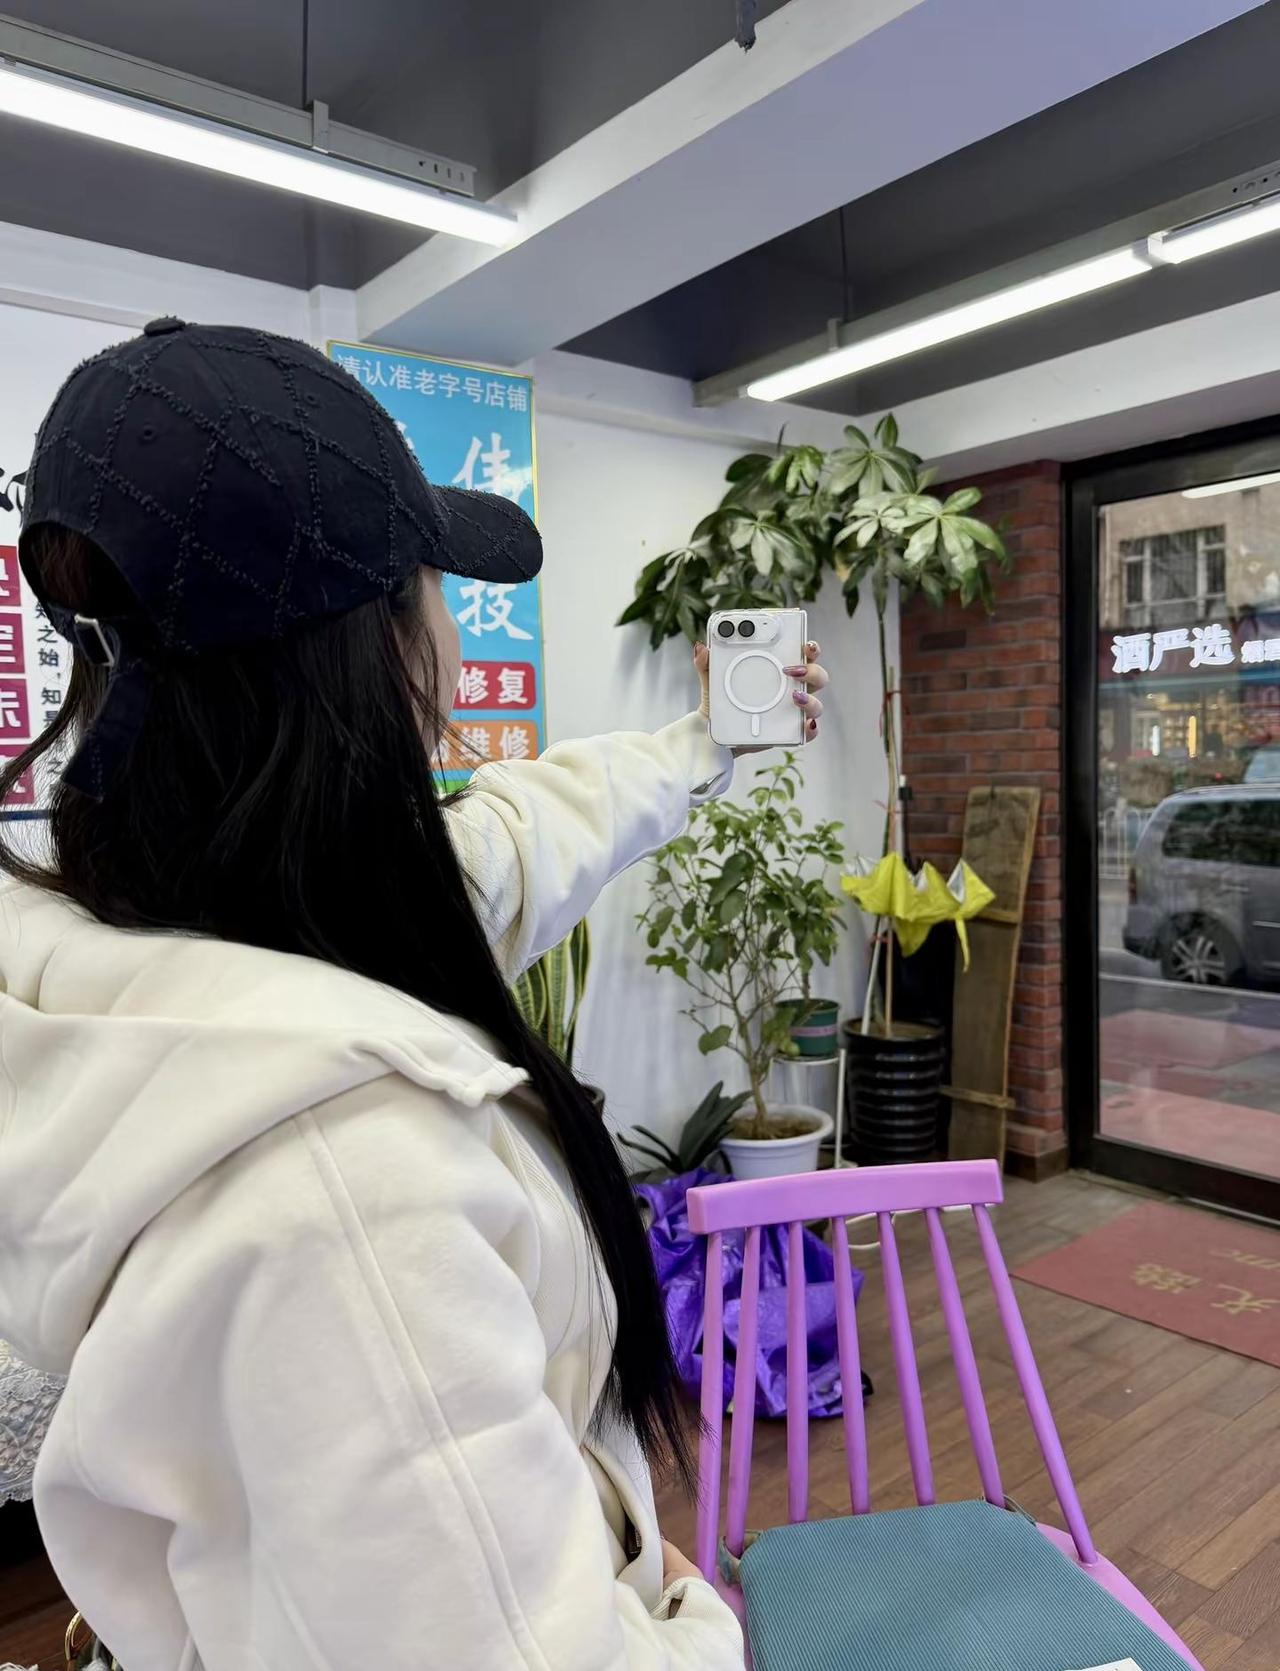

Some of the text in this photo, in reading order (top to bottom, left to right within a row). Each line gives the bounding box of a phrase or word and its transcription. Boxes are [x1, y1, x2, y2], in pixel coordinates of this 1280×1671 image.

[337, 354, 527, 412] 请认准老字号店铺
[1111, 623, 1236, 674] 酒严选
